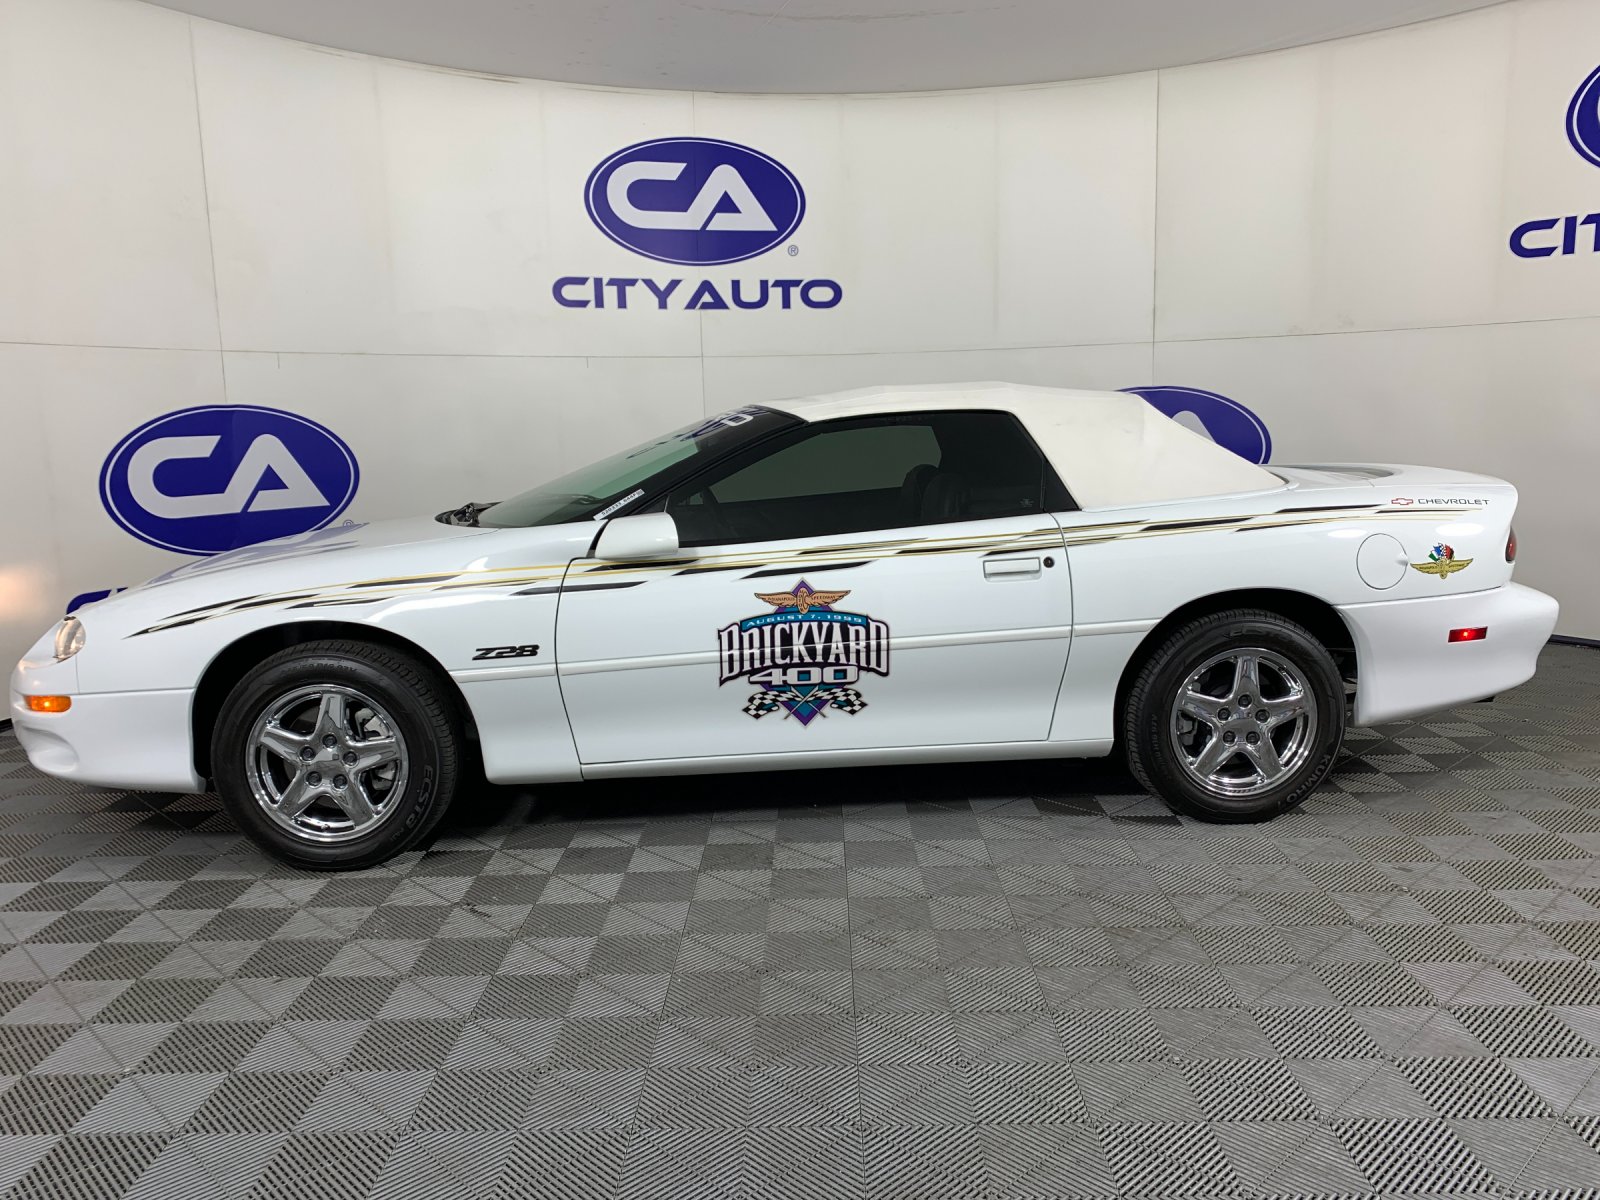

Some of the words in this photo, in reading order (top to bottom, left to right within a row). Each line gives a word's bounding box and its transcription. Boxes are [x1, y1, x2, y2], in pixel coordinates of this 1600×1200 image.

[606, 161, 778, 231] CA
[552, 277, 683, 310] CITY
[684, 279, 843, 310] AUTO
[127, 433, 331, 519] CA
[746, 614, 802, 627] AUGUST
[472, 644, 540, 660] Z28
[719, 620, 888, 681] BRICKYARD
[750, 666, 859, 686] 400
[1286, 754, 1331, 802] KUMHO
